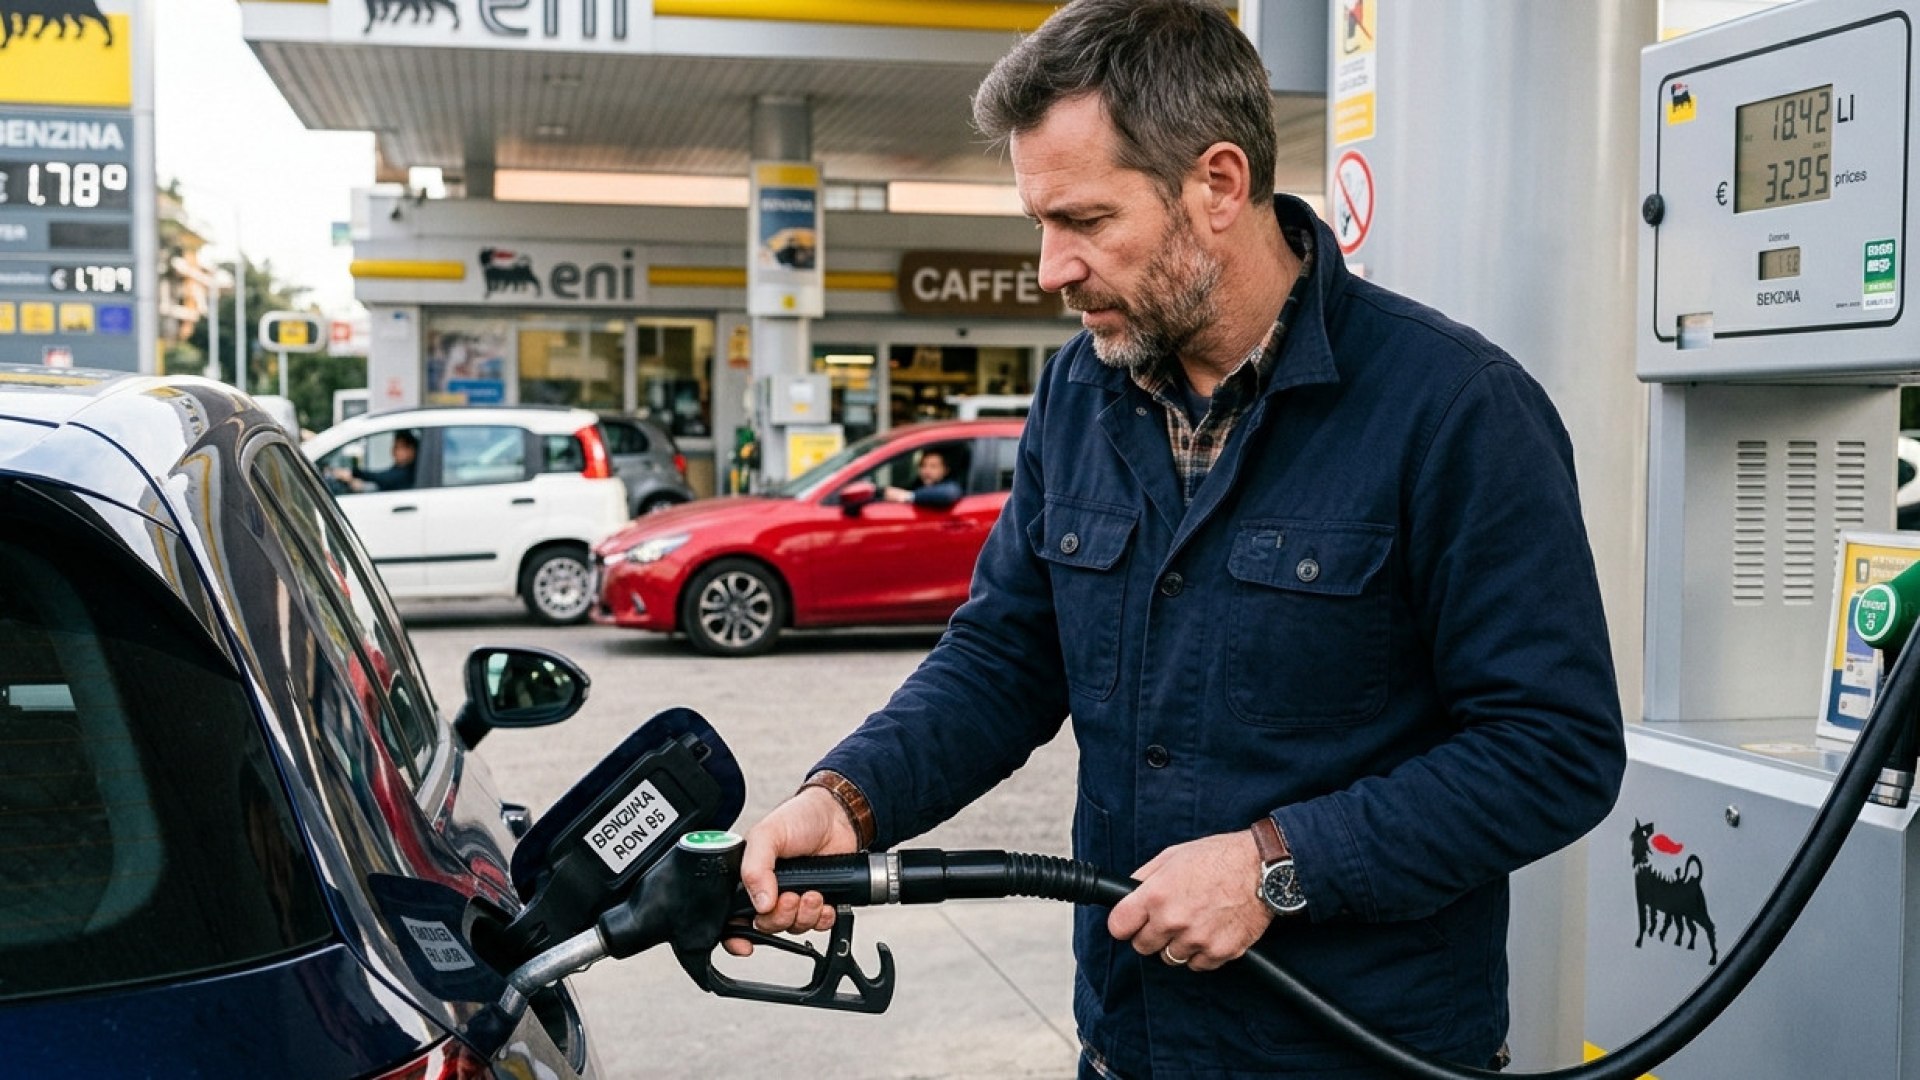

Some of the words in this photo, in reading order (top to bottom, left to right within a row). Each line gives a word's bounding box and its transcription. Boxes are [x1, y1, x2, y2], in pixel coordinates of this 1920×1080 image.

[0, 119, 125, 150] ENZINA
[1773, 91, 1830, 141] 18.42
[1715, 181, 1728, 206] €
[1765, 153, 1829, 203] 32.95
[1834, 170, 1867, 188] prices
[550, 247, 635, 300] eni
[912, 261, 1040, 303] CAFFÈ
[612, 824, 649, 860] RON
